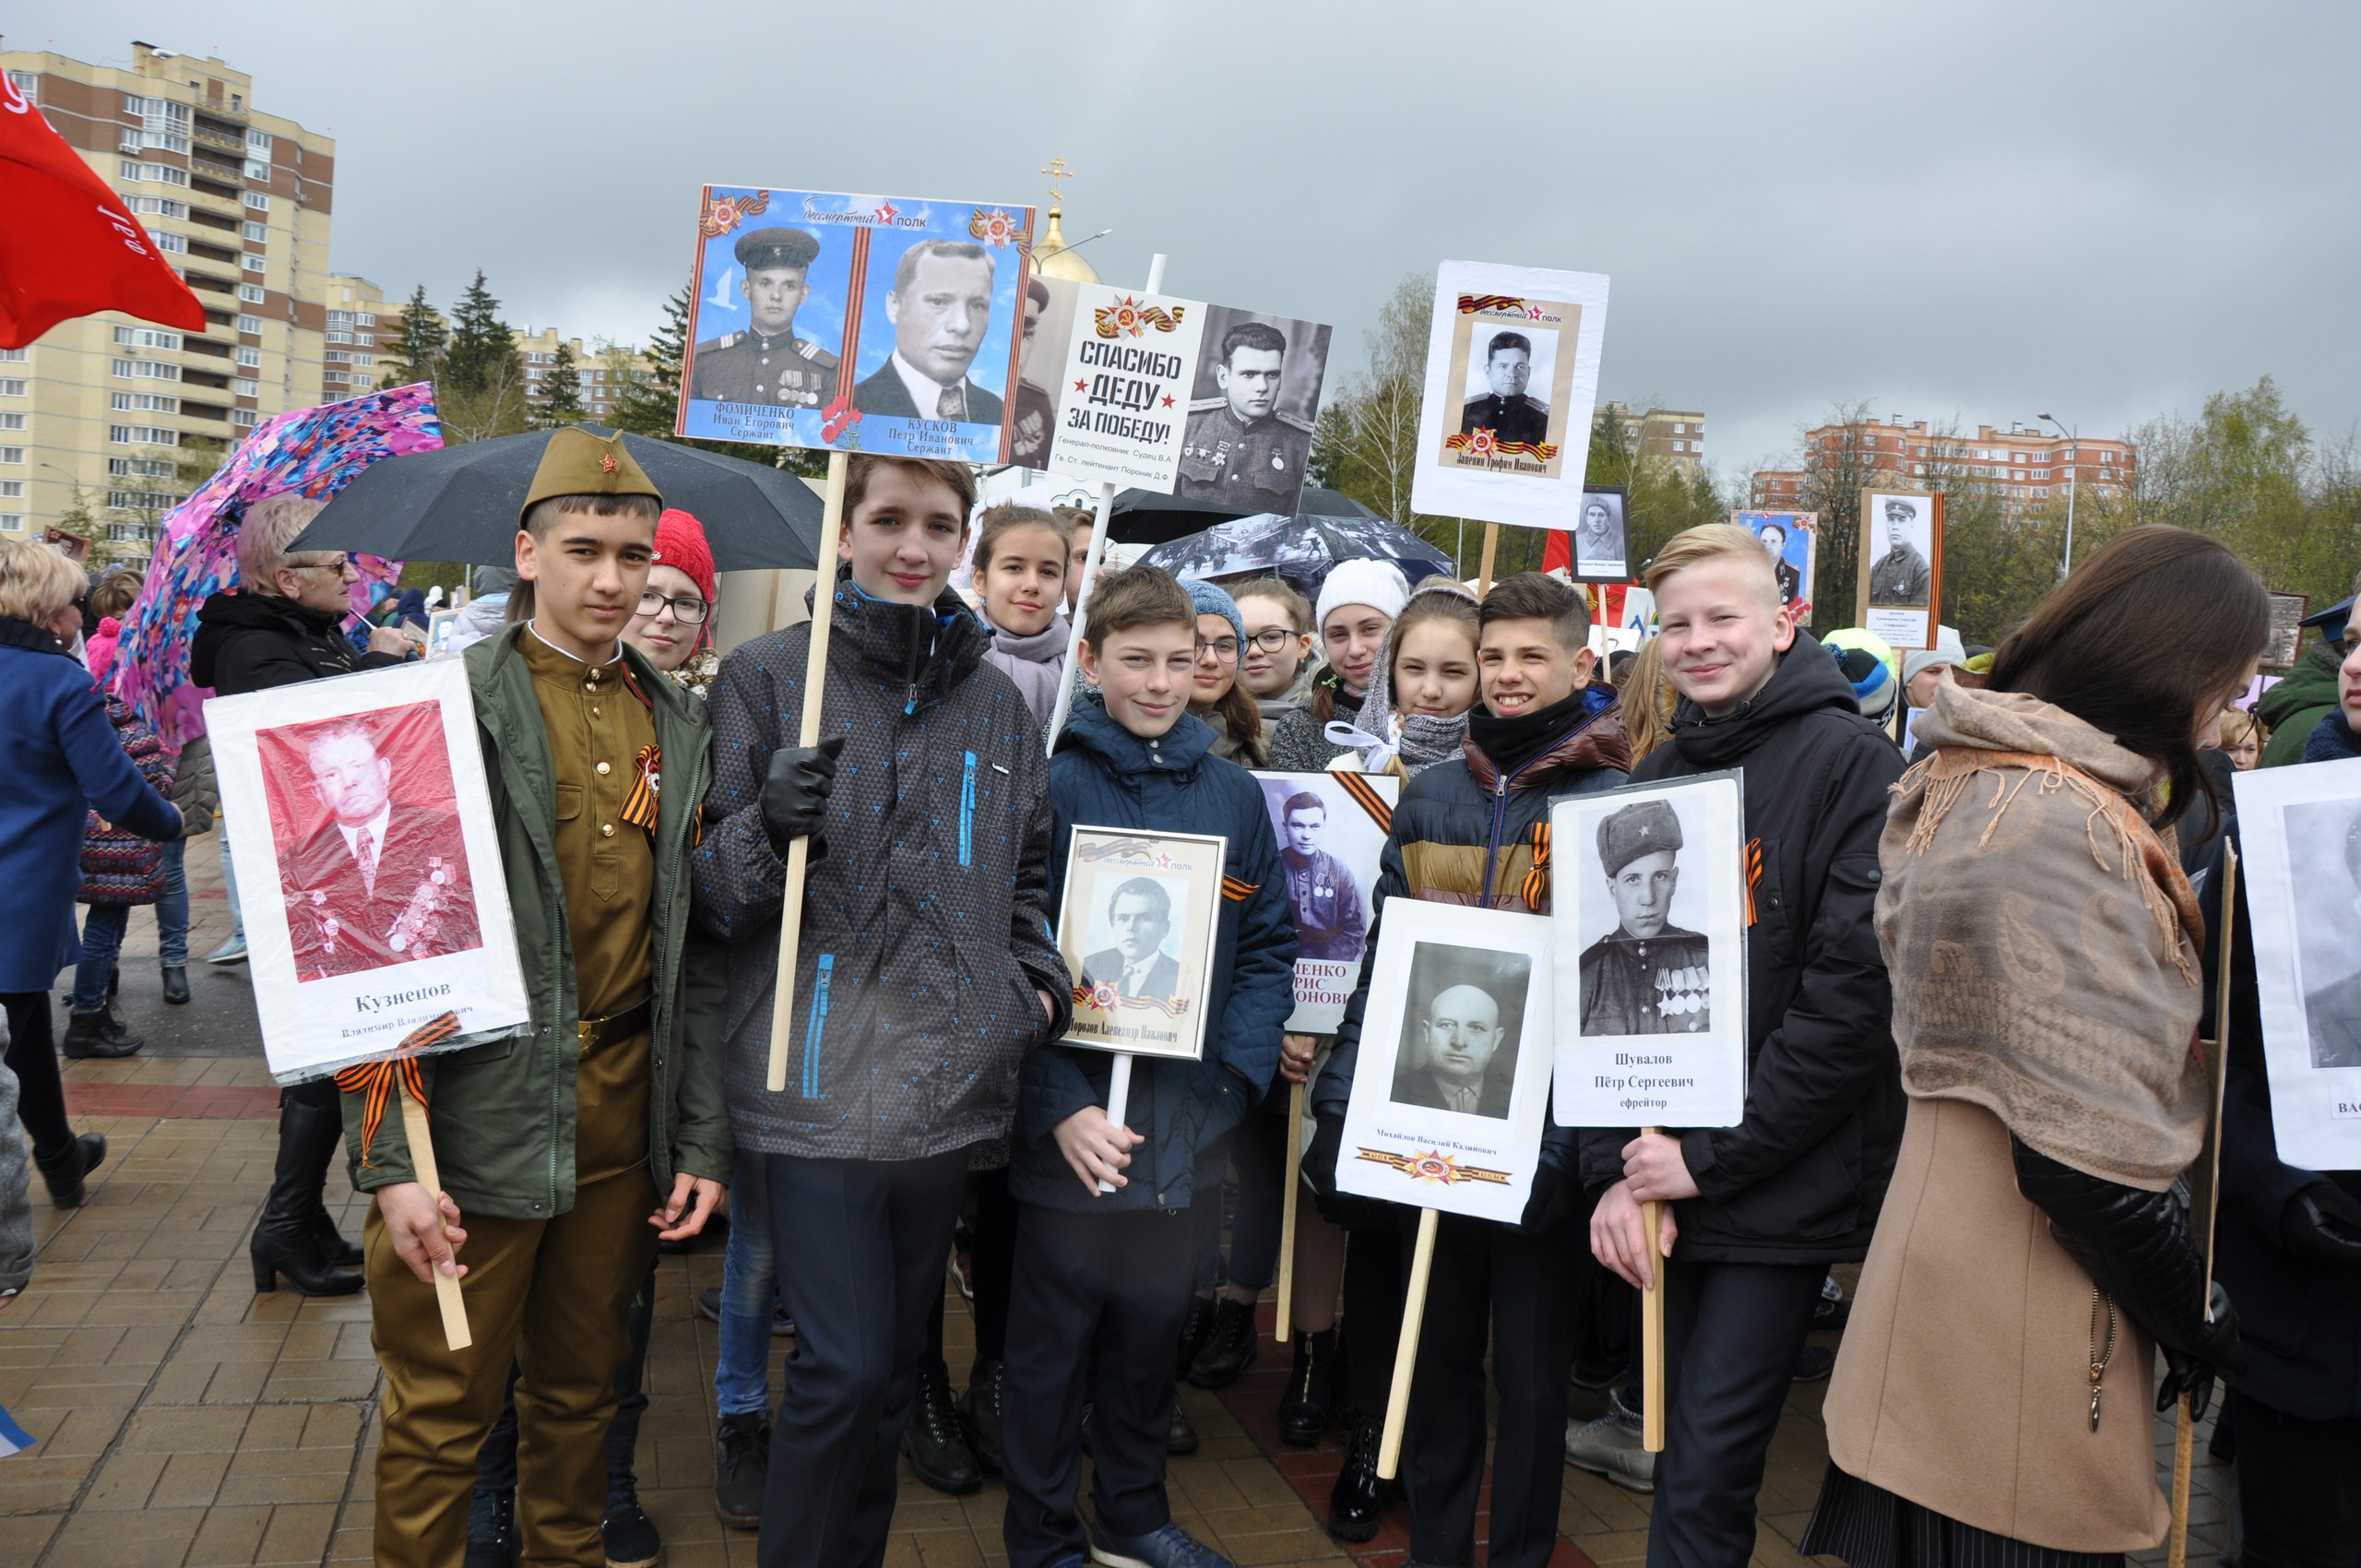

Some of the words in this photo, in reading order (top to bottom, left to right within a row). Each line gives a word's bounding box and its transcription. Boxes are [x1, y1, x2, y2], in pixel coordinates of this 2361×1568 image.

[803, 196, 875, 224] бессмертный
[1079, 339, 1182, 380] СПАСИБО
[1088, 374, 1160, 412] ДЕДУ
[715, 402, 795, 420] ФОМИЧЕНКО
[713, 413, 740, 427] Иван
[745, 416, 795, 431] Егорович
[907, 419, 957, 434] КУСКОВ
[1067, 407, 1091, 431] ЗА
[1094, 411, 1171, 445] ПОБЕДУ!
[730, 426, 775, 440] Сержант
[888, 428, 918, 443] Петр
[919, 432, 974, 446] Иванович
[907, 441, 953, 456] Сержант
[1058, 435, 1130, 456] Генерал-полковник
[1081, 458, 1120, 473] лейтенант
[1513, 457, 1548, 473] Иванович
[1295, 963, 1347, 978] ЕНКО
[1294, 977, 1326, 991] РИС
[355, 983, 451, 1014] Кузнецов
[342, 1022, 395, 1039] Владимир
[397, 1006, 473, 1027] Владимивич
[1099, 1020, 1139, 1042] Александр
[1615, 1052, 1673, 1068] Шувалов
[1595, 1075, 1625, 1090] Пётр
[1628, 1075, 1694, 1090] Сергеевич
[1619, 1098, 1667, 1110] ефрейтор
[2338, 1102, 2361, 1113] ВА
[1376, 1128, 1416, 1142] Михайлов
[1418, 1135, 1451, 1147] Василий
